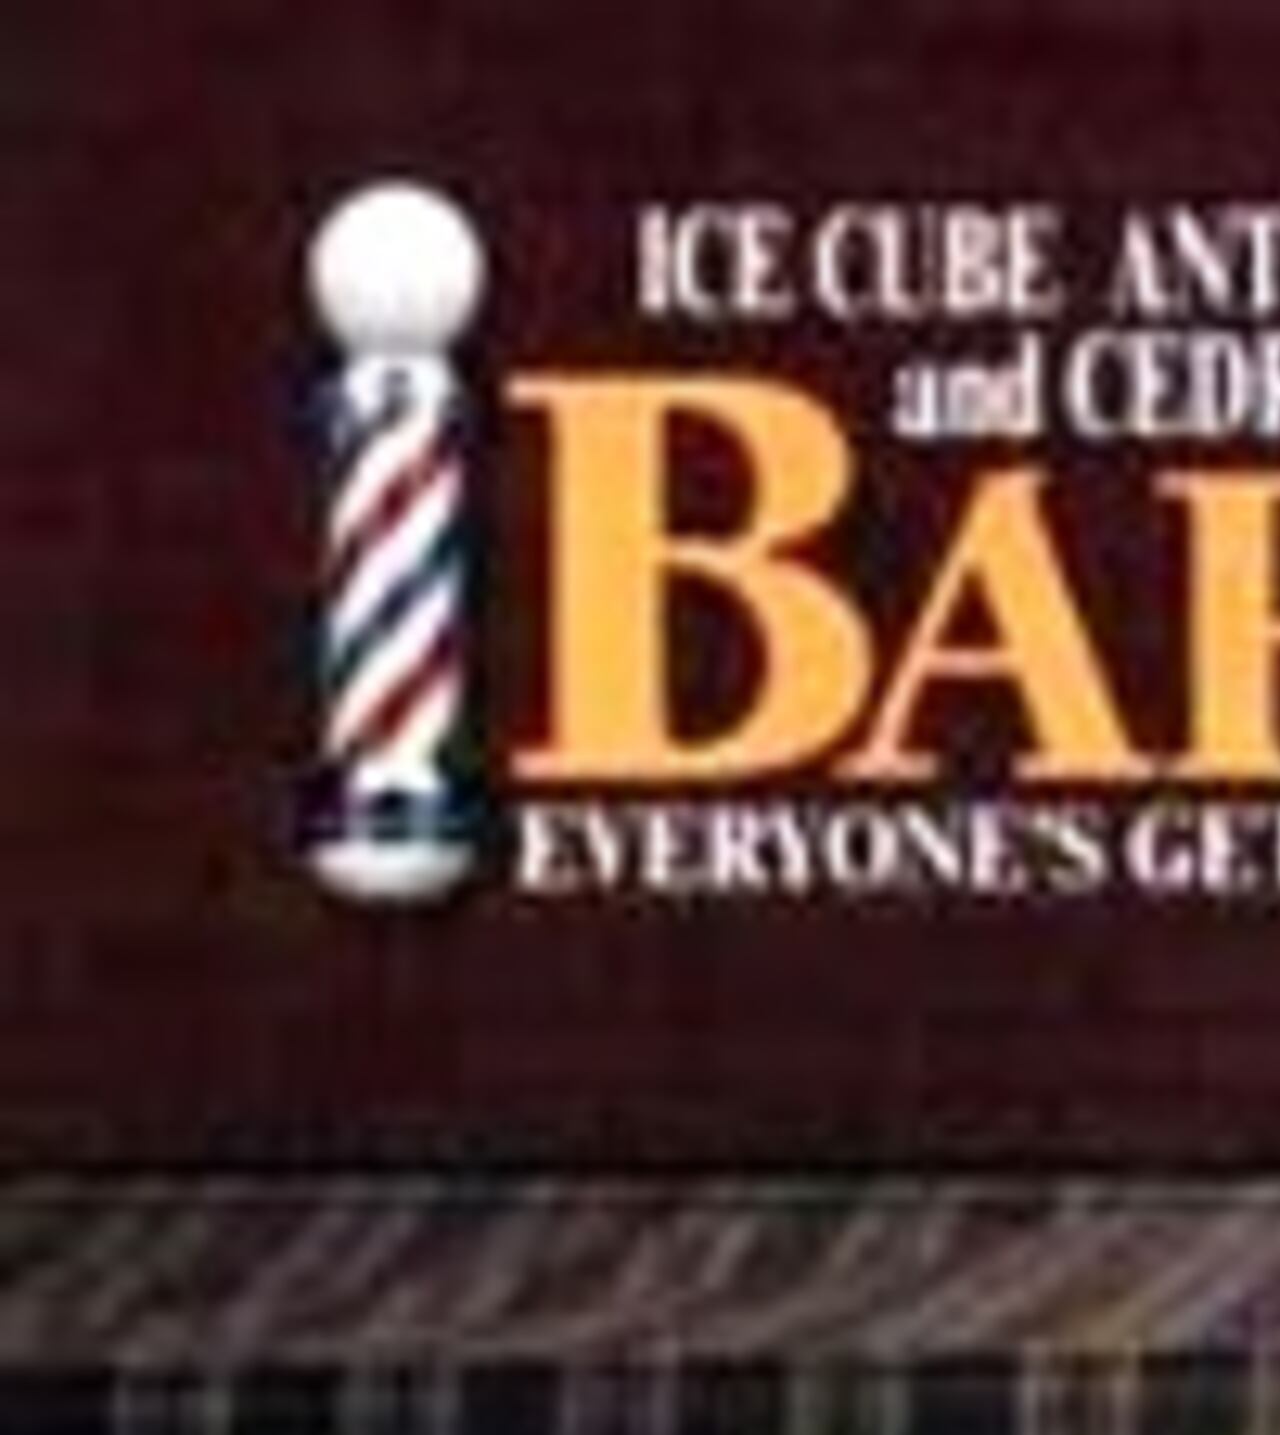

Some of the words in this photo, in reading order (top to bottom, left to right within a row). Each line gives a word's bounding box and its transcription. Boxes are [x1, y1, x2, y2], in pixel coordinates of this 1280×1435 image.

[637, 206, 793, 315] ICE
[811, 206, 1054, 318] CUBE
[889, 331, 1045, 440] and
[516, 802, 1109, 891] EVERYONE'S
